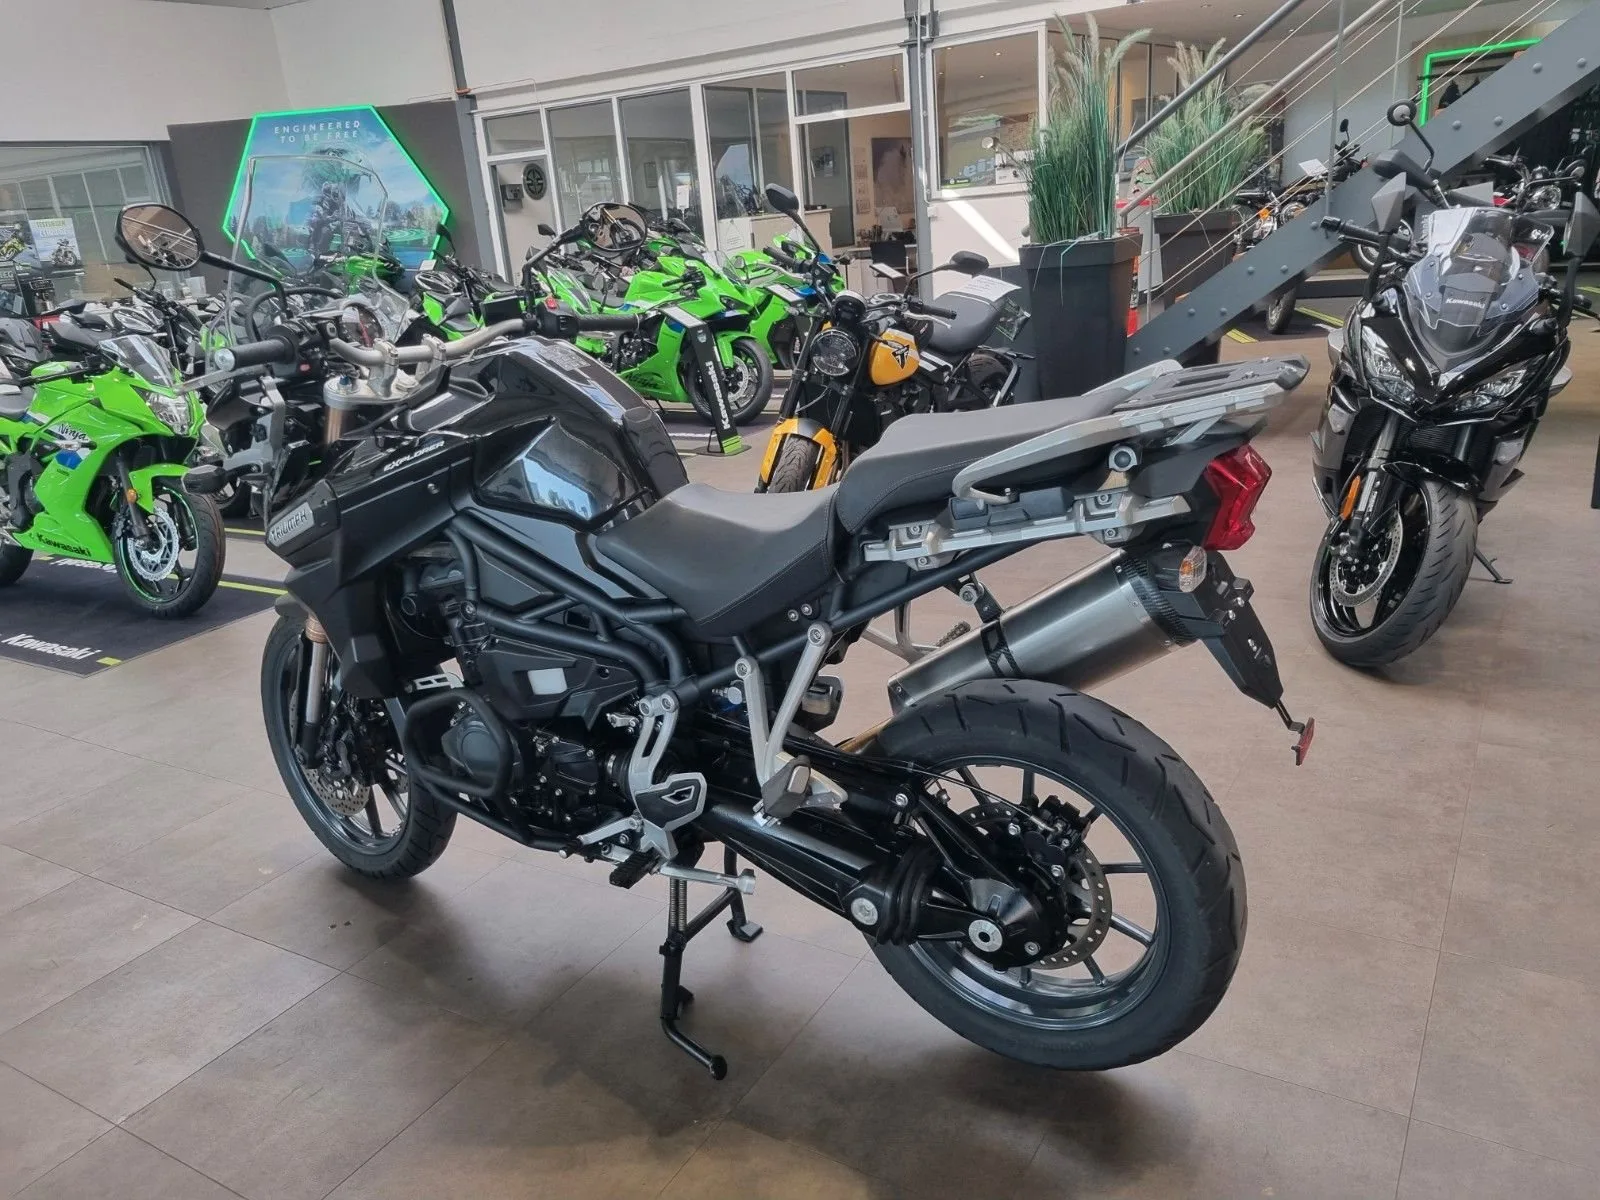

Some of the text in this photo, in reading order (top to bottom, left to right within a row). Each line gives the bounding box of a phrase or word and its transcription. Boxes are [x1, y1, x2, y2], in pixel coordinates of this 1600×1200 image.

[274, 120, 360, 134] ENGINEERED
[280, 129, 358, 144] TO BE FREE
[1446, 297, 1486, 309] Kawasaki
[705, 360, 731, 430] Kawasaki
[58, 423, 89, 441] Ninja
[383, 440, 445, 472] EXPLORER
[269, 508, 308, 542] TRIUMPH
[36, 532, 92, 557] Kawasaki
[0, 633, 103, 661] Kawasaki
